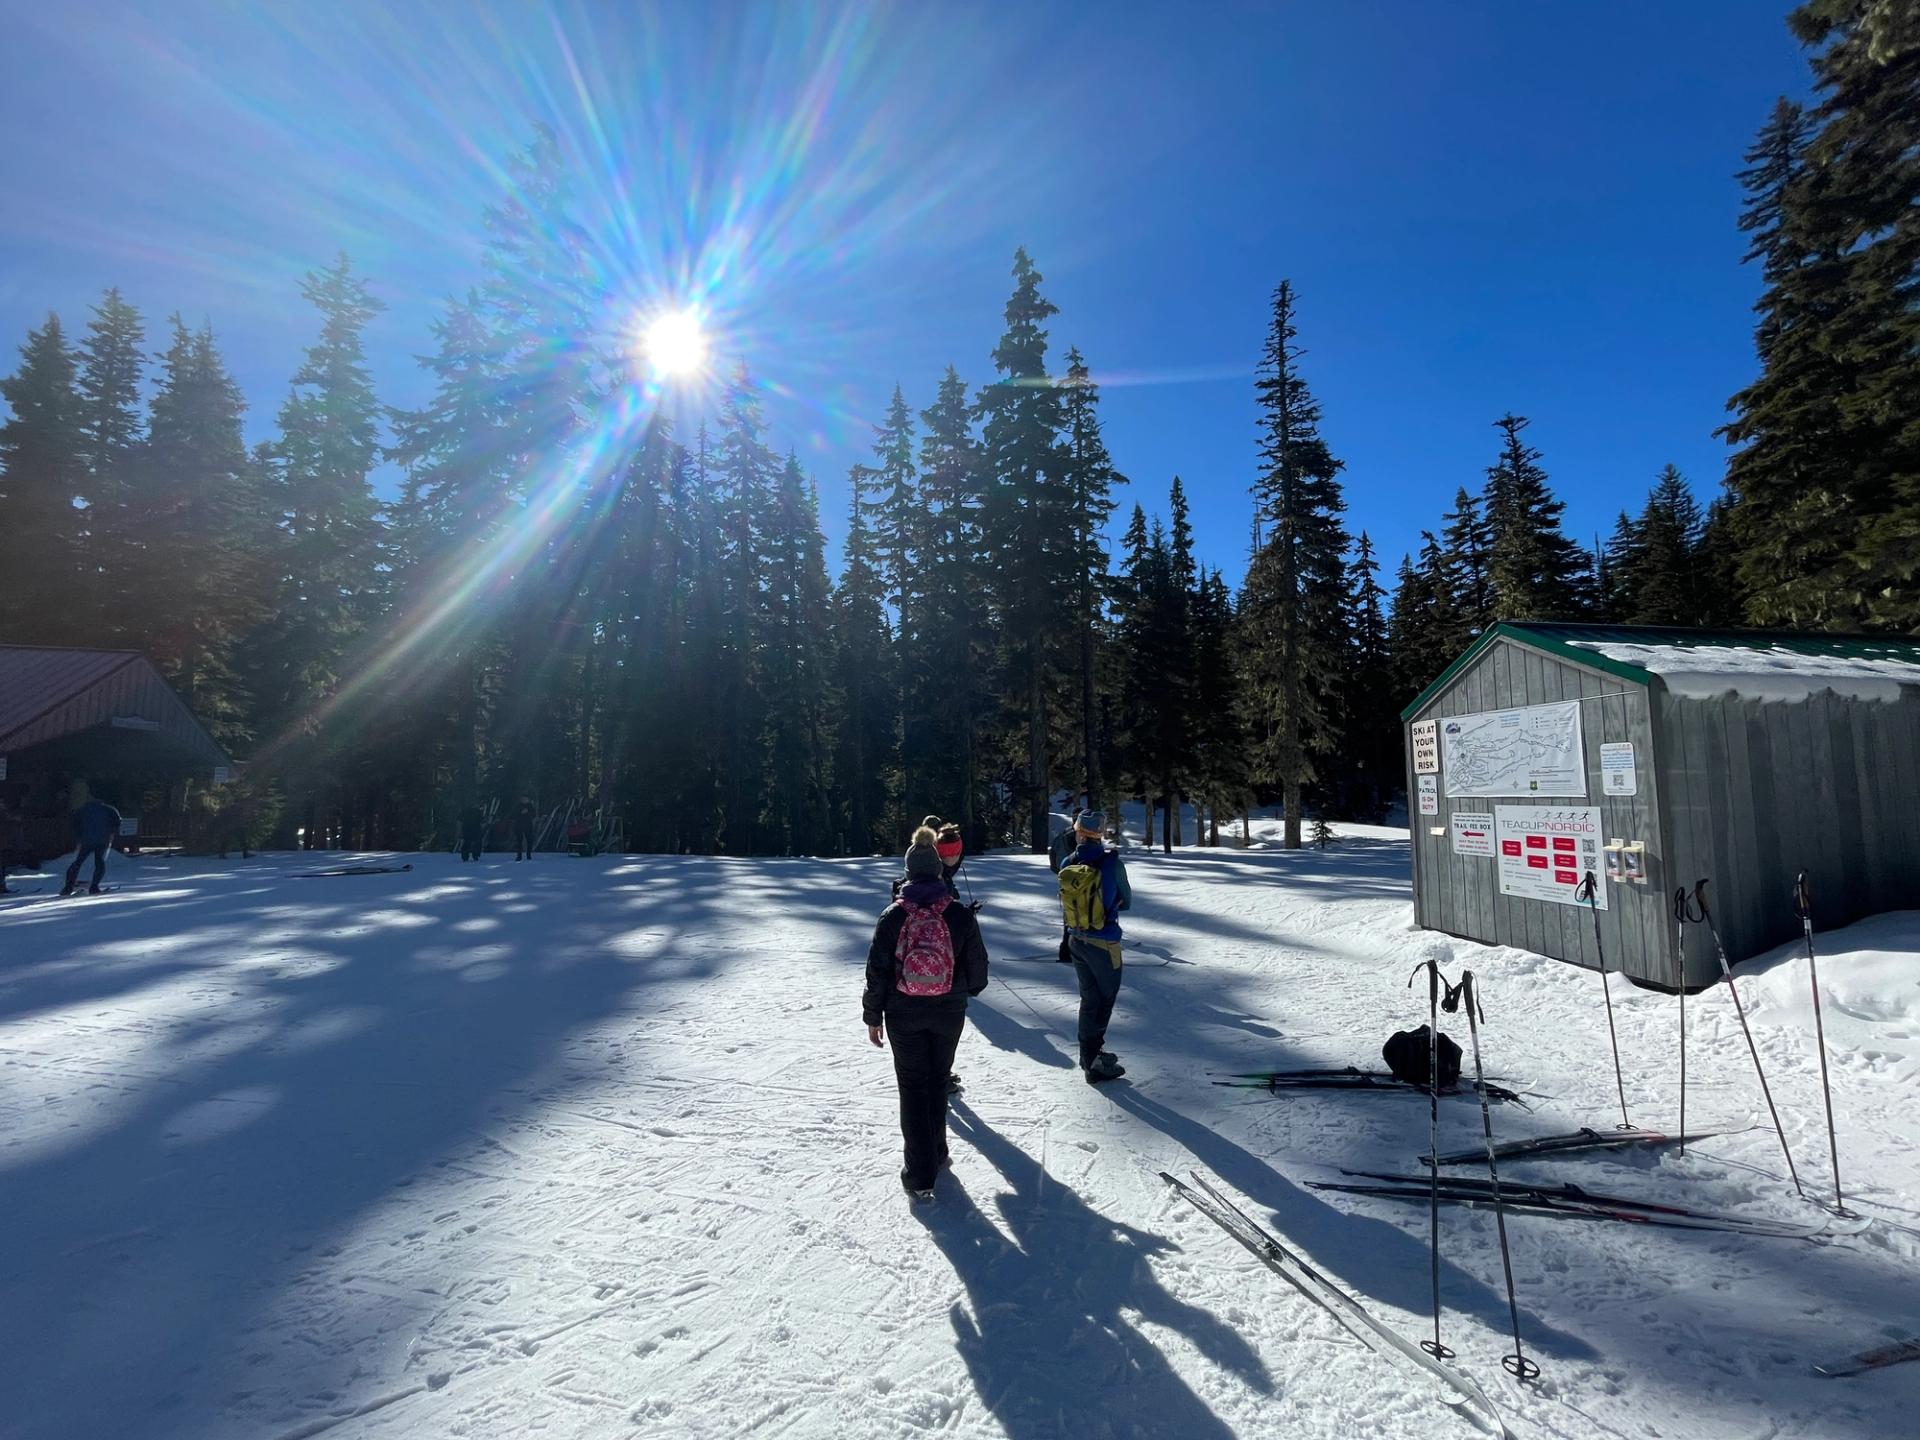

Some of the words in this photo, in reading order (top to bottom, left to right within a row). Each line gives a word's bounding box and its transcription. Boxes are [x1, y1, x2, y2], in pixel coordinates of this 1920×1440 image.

[1413, 727, 1425, 735] SKI
[1427, 725, 1435, 734] AT
[1415, 737, 1434, 746] YOUR
[1417, 749, 1434, 758] OWN
[1418, 761, 1435, 770] RISK
[1501, 820, 1595, 833] TEACUPNORDIC
